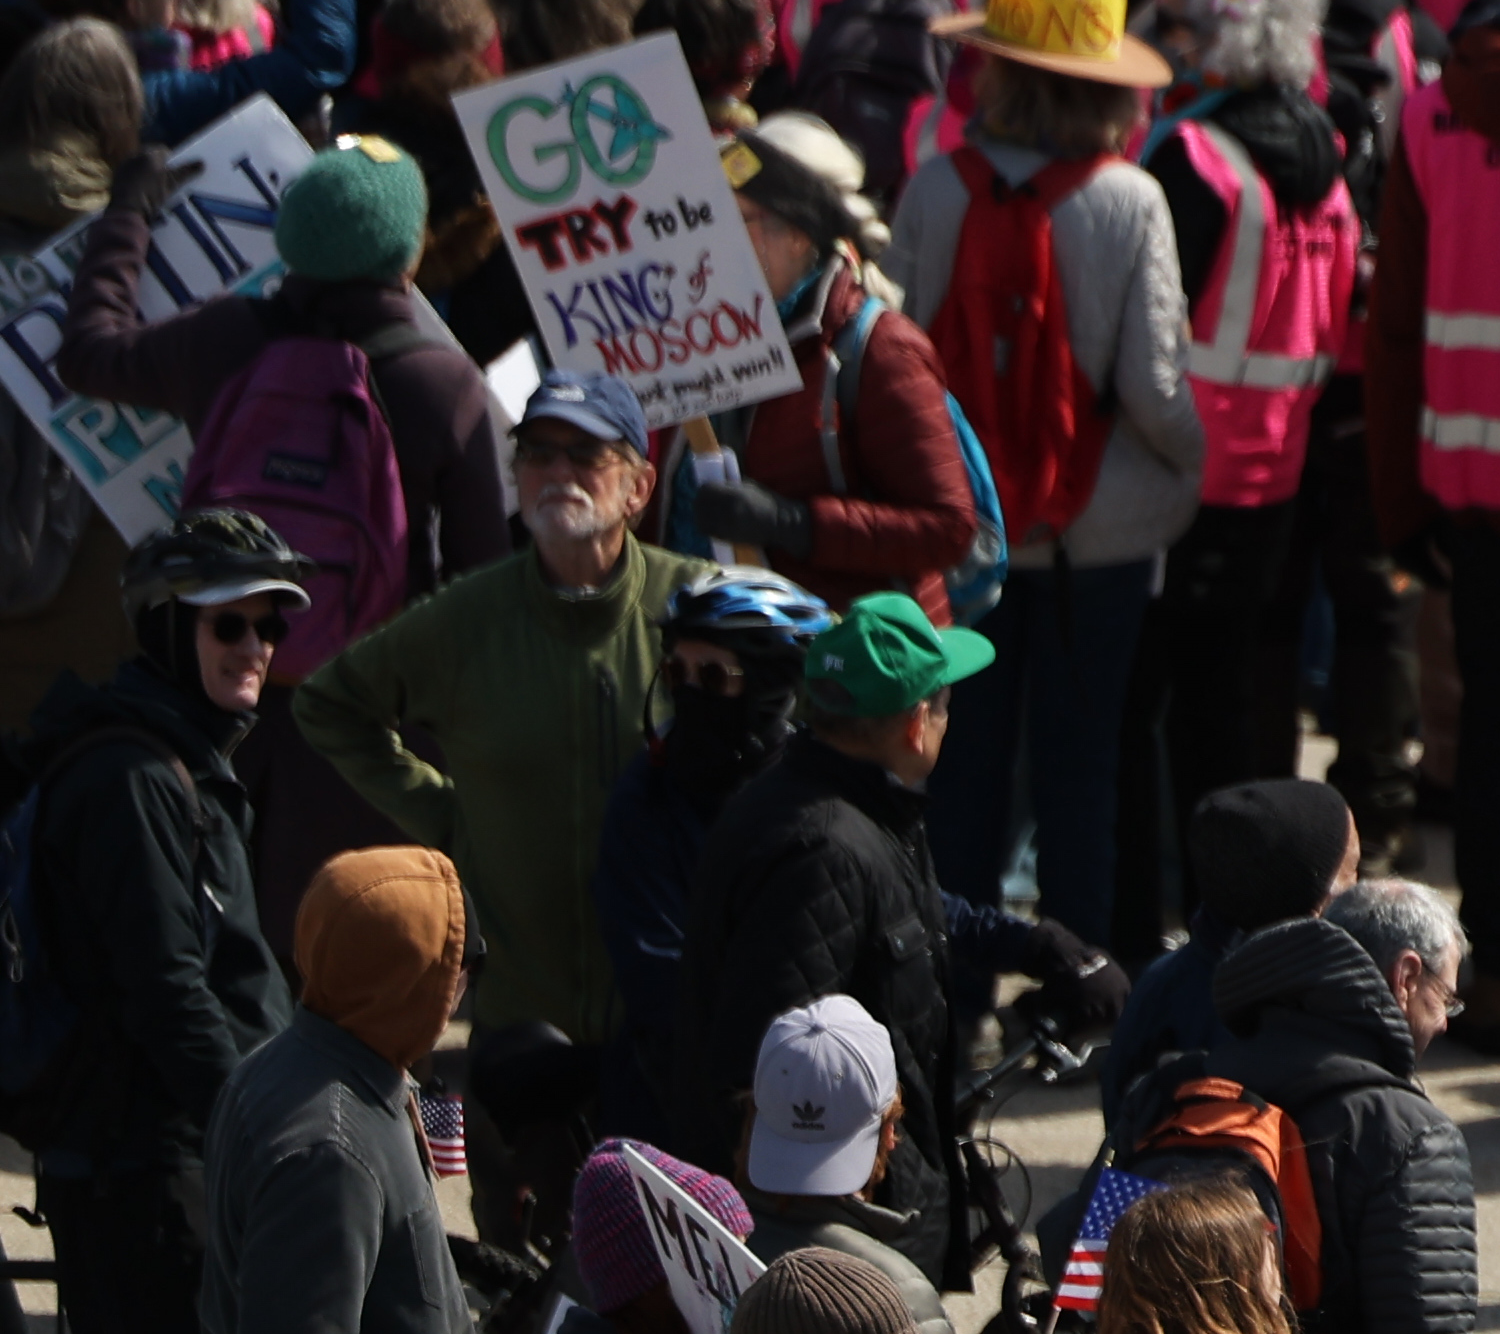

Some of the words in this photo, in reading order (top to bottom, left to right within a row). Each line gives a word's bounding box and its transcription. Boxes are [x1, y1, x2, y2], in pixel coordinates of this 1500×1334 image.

[485, 73, 658, 205] GO
[516, 191, 640, 274] TRY
[644, 208, 678, 240] to
[681, 197, 715, 234] be
[546, 262, 674, 351] KING
[687, 250, 714, 306] of
[595, 292, 764, 376] MOSCOW
